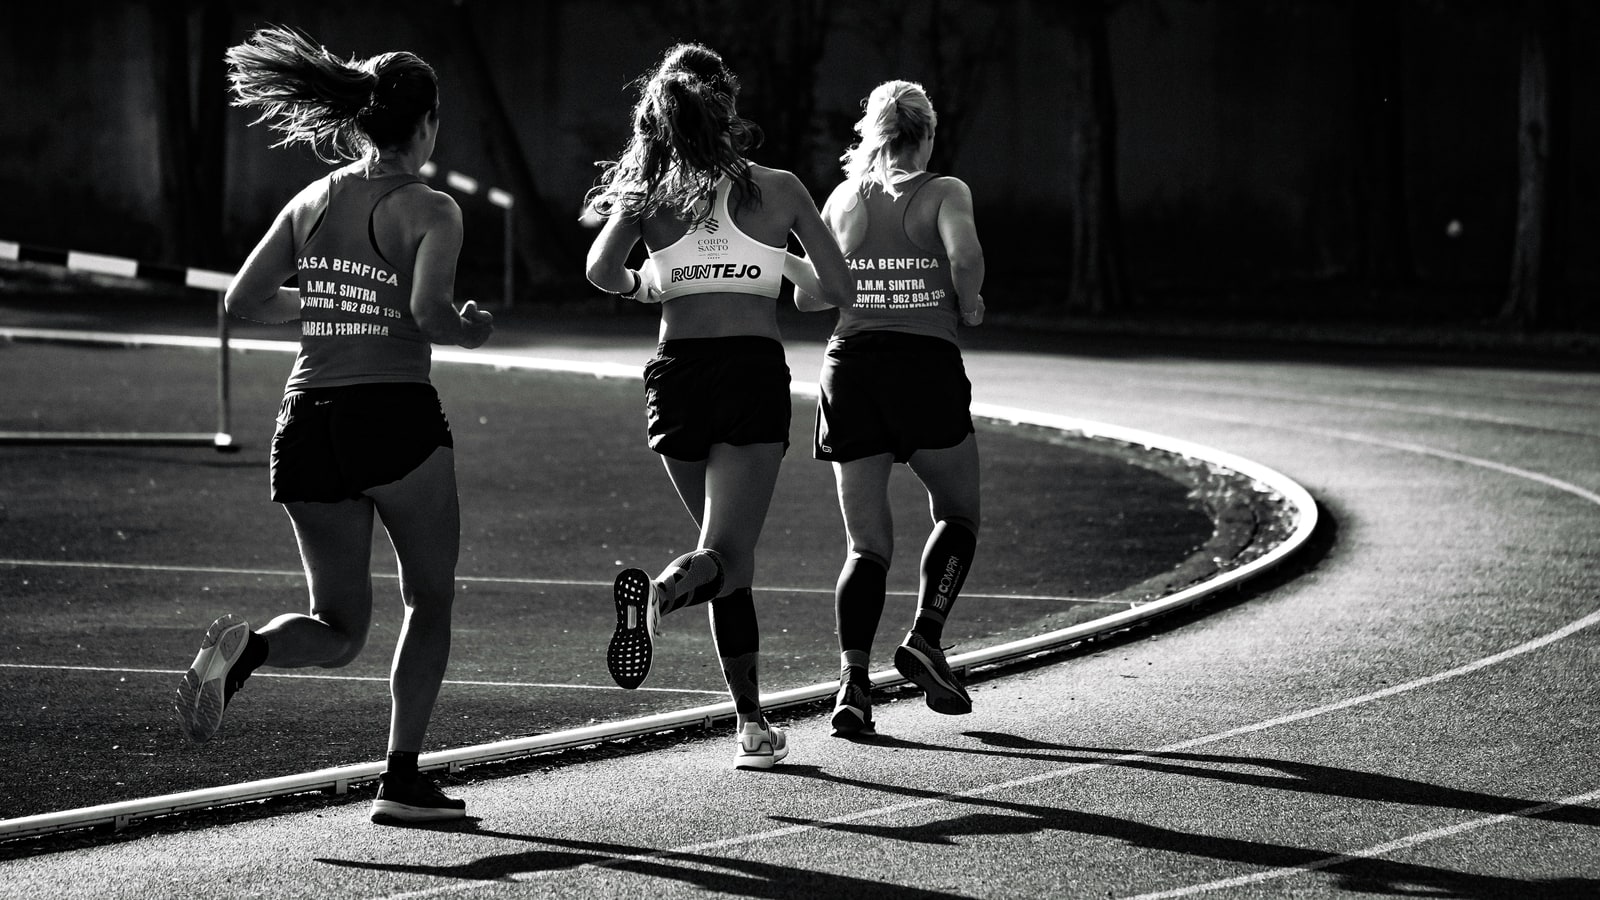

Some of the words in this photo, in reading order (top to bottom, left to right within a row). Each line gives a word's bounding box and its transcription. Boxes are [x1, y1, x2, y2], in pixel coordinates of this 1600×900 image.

[297, 257, 328, 270] CASA
[333, 259, 398, 286] BENFICA
[671, 264, 761, 283] RUNTEJO
[879, 258, 939, 270] BENFICA
[307, 281, 337, 295] A.M.M.
[340, 284, 377, 303] SINTRA
[857, 280, 886, 291] A.M.M.
[889, 279, 925, 291] SINTRA
[856, 294, 885, 303] SINTRA
[893, 294, 910, 303] 962
[912, 292, 929, 303] 894
[931, 289, 945, 300] 135
[306, 297, 334, 309] SINTRA
[341, 301, 359, 312] 962
[360, 303, 380, 315] 894
[383, 307, 401, 319] 135
